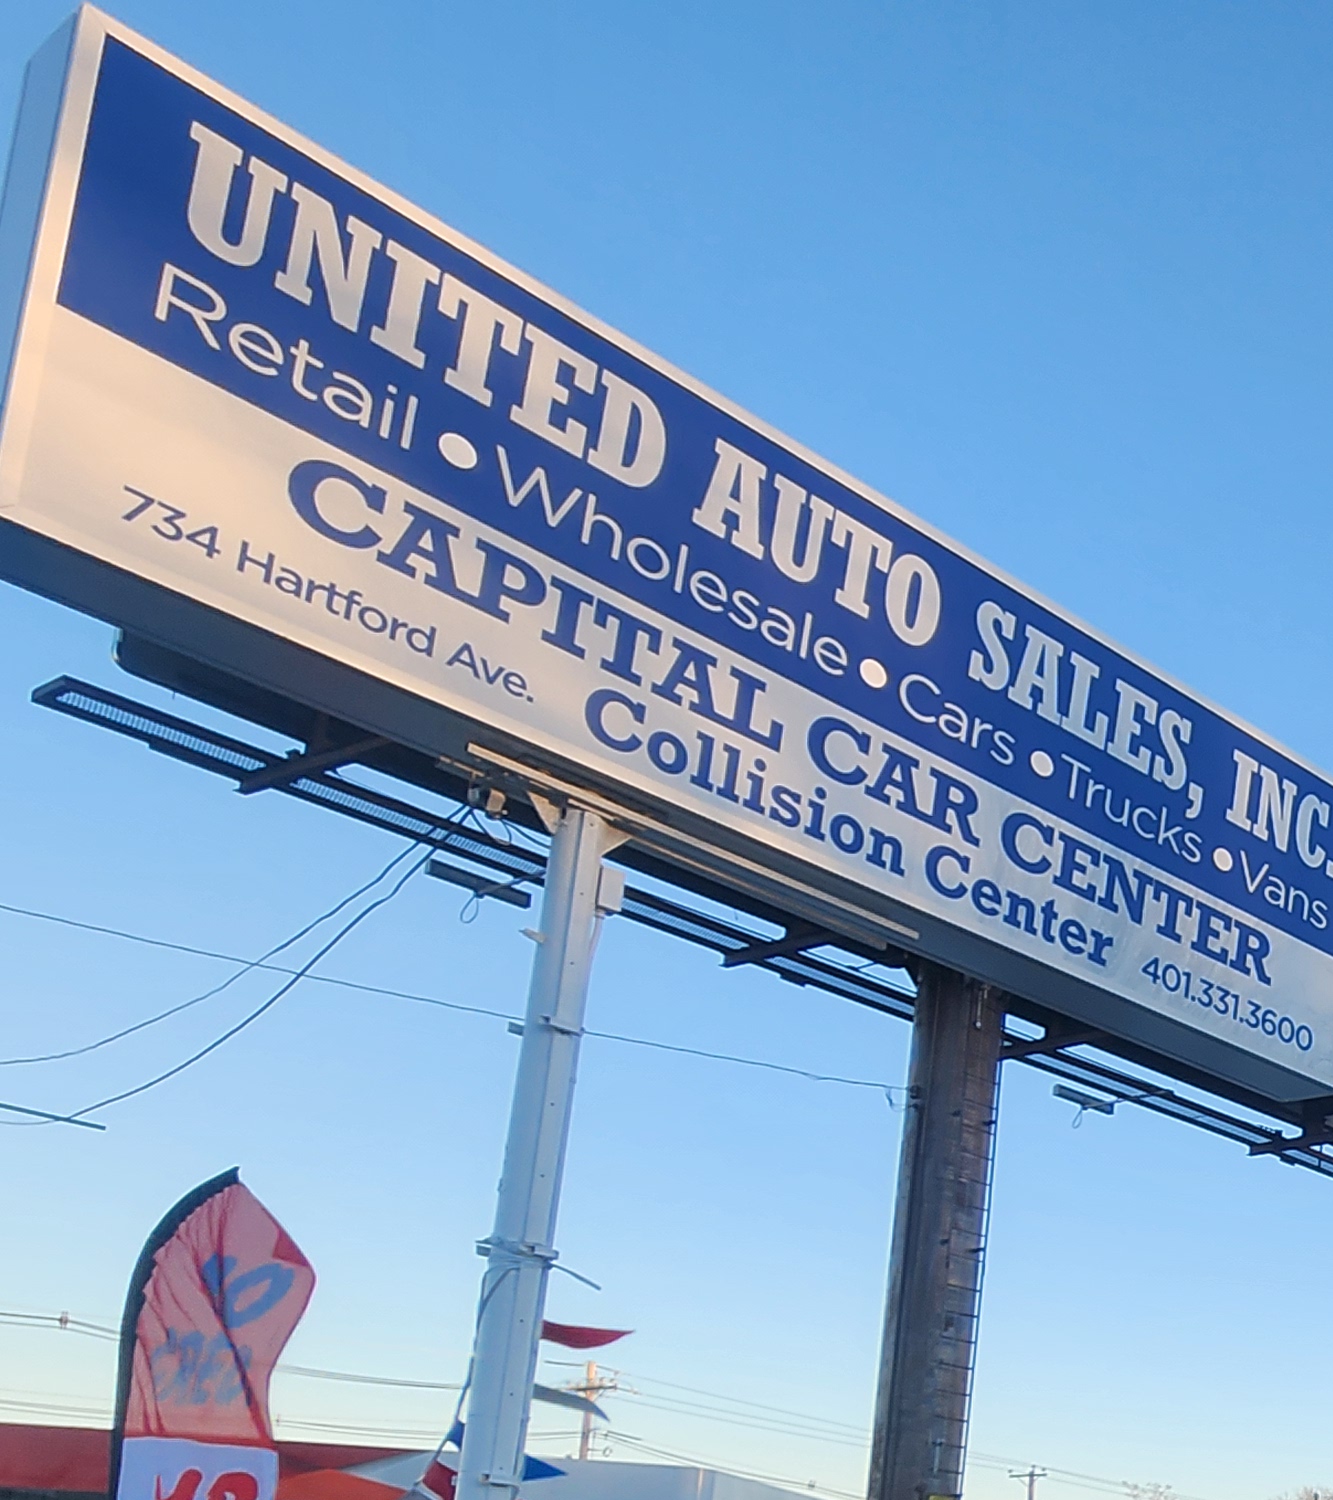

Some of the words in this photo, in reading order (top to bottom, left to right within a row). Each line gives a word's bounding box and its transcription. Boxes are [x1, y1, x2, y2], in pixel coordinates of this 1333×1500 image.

[119, 486, 221, 558] 734
[236, 540, 436, 653] Hartford
[446, 643, 534, 702] Ave.
[154, 263, 418, 449] Retail
[497, 445, 848, 676] Wholesale
[900, 673, 1014, 765] Cars
[1062, 753, 1202, 863] Trucks
[1238, 850, 1328, 930] Vans
[187, 121, 667, 488] UNITED
[692, 438, 941, 646] AUTO
[967, 601, 1202, 818] SALES,
[288, 459, 783, 752] CAPITAL
[807, 715, 980, 846] CAR
[1002, 812, 1272, 985] CENTER
[585, 688, 905, 877] Collision
[925, 844, 1114, 967] Center
[1141, 955, 1314, 1052] 401.331.3600
